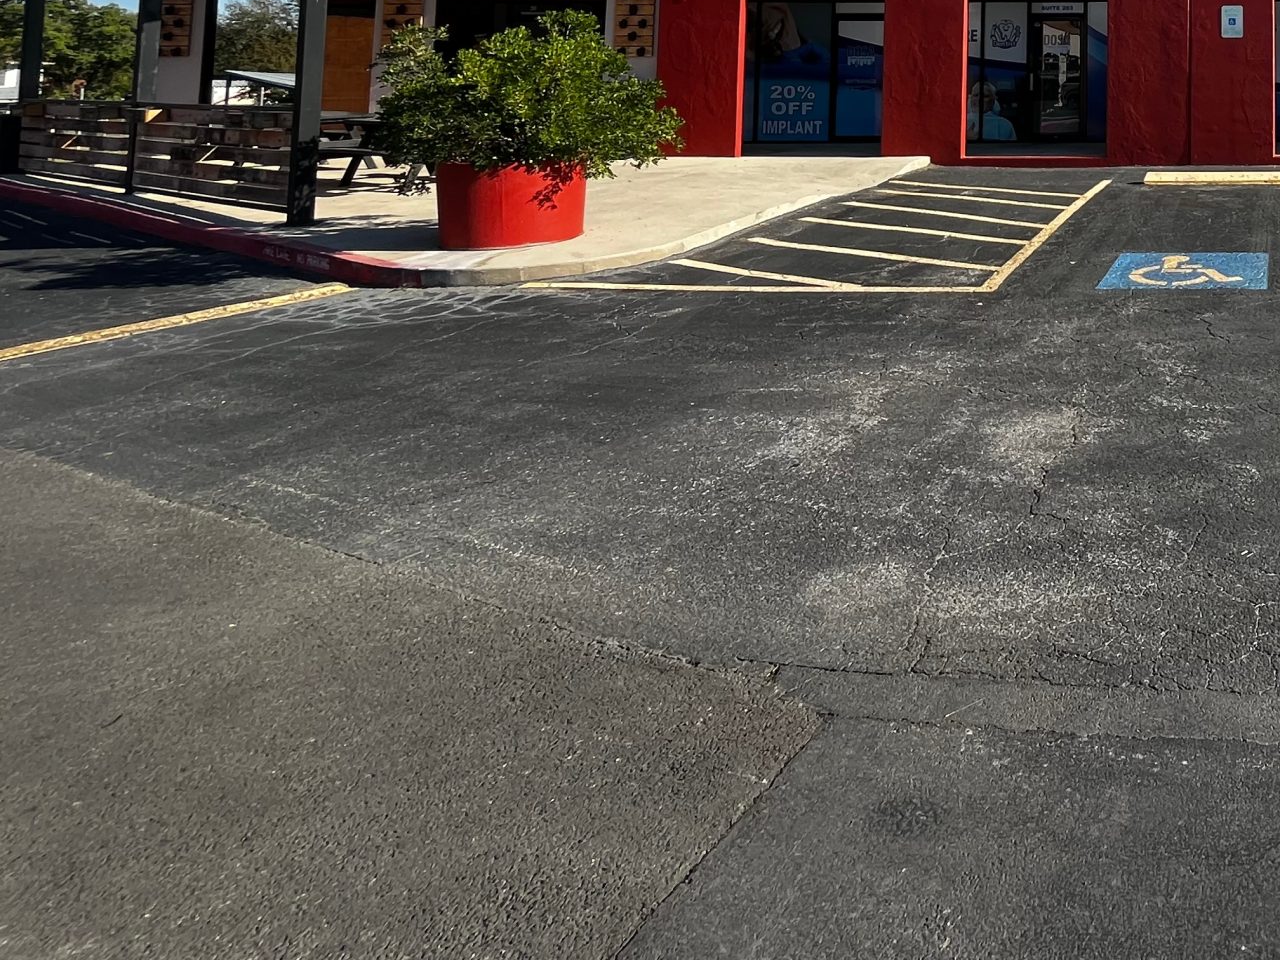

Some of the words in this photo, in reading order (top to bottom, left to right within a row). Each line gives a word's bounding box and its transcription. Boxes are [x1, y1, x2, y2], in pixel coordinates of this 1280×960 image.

[769, 84, 816, 99] 20%
[771, 101, 814, 115] OFF
[762, 120, 823, 135] IMPLANT
